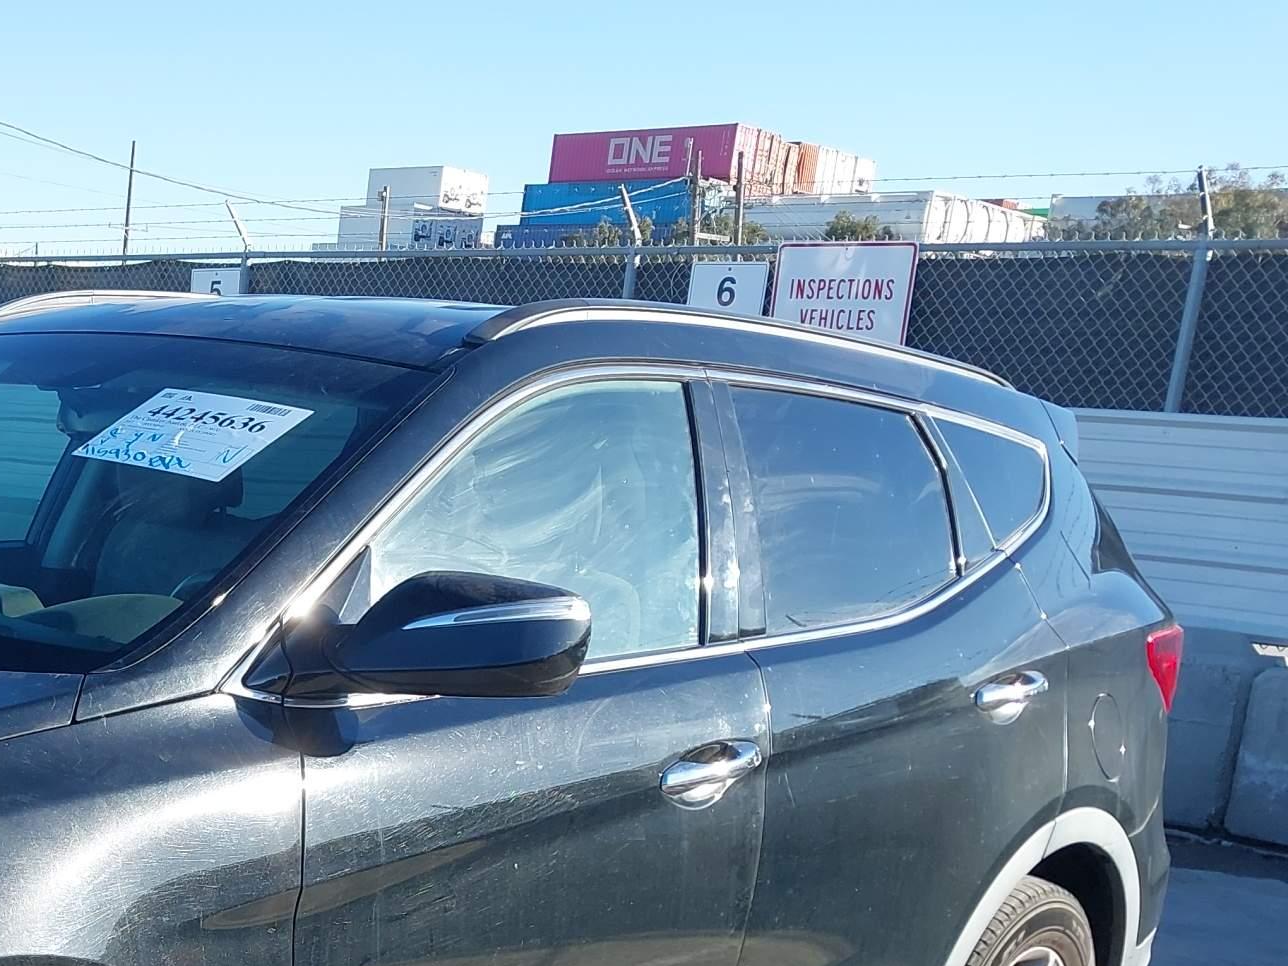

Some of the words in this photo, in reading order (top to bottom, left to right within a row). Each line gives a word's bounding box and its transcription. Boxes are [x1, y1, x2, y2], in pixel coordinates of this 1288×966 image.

[607, 135, 672, 165] ONE
[716, 276, 737, 307] 6
[789, 278, 895, 301] INSPECTIONS
[800, 309, 876, 331] VEHICLES
[148, 404, 274, 434] 44245636
